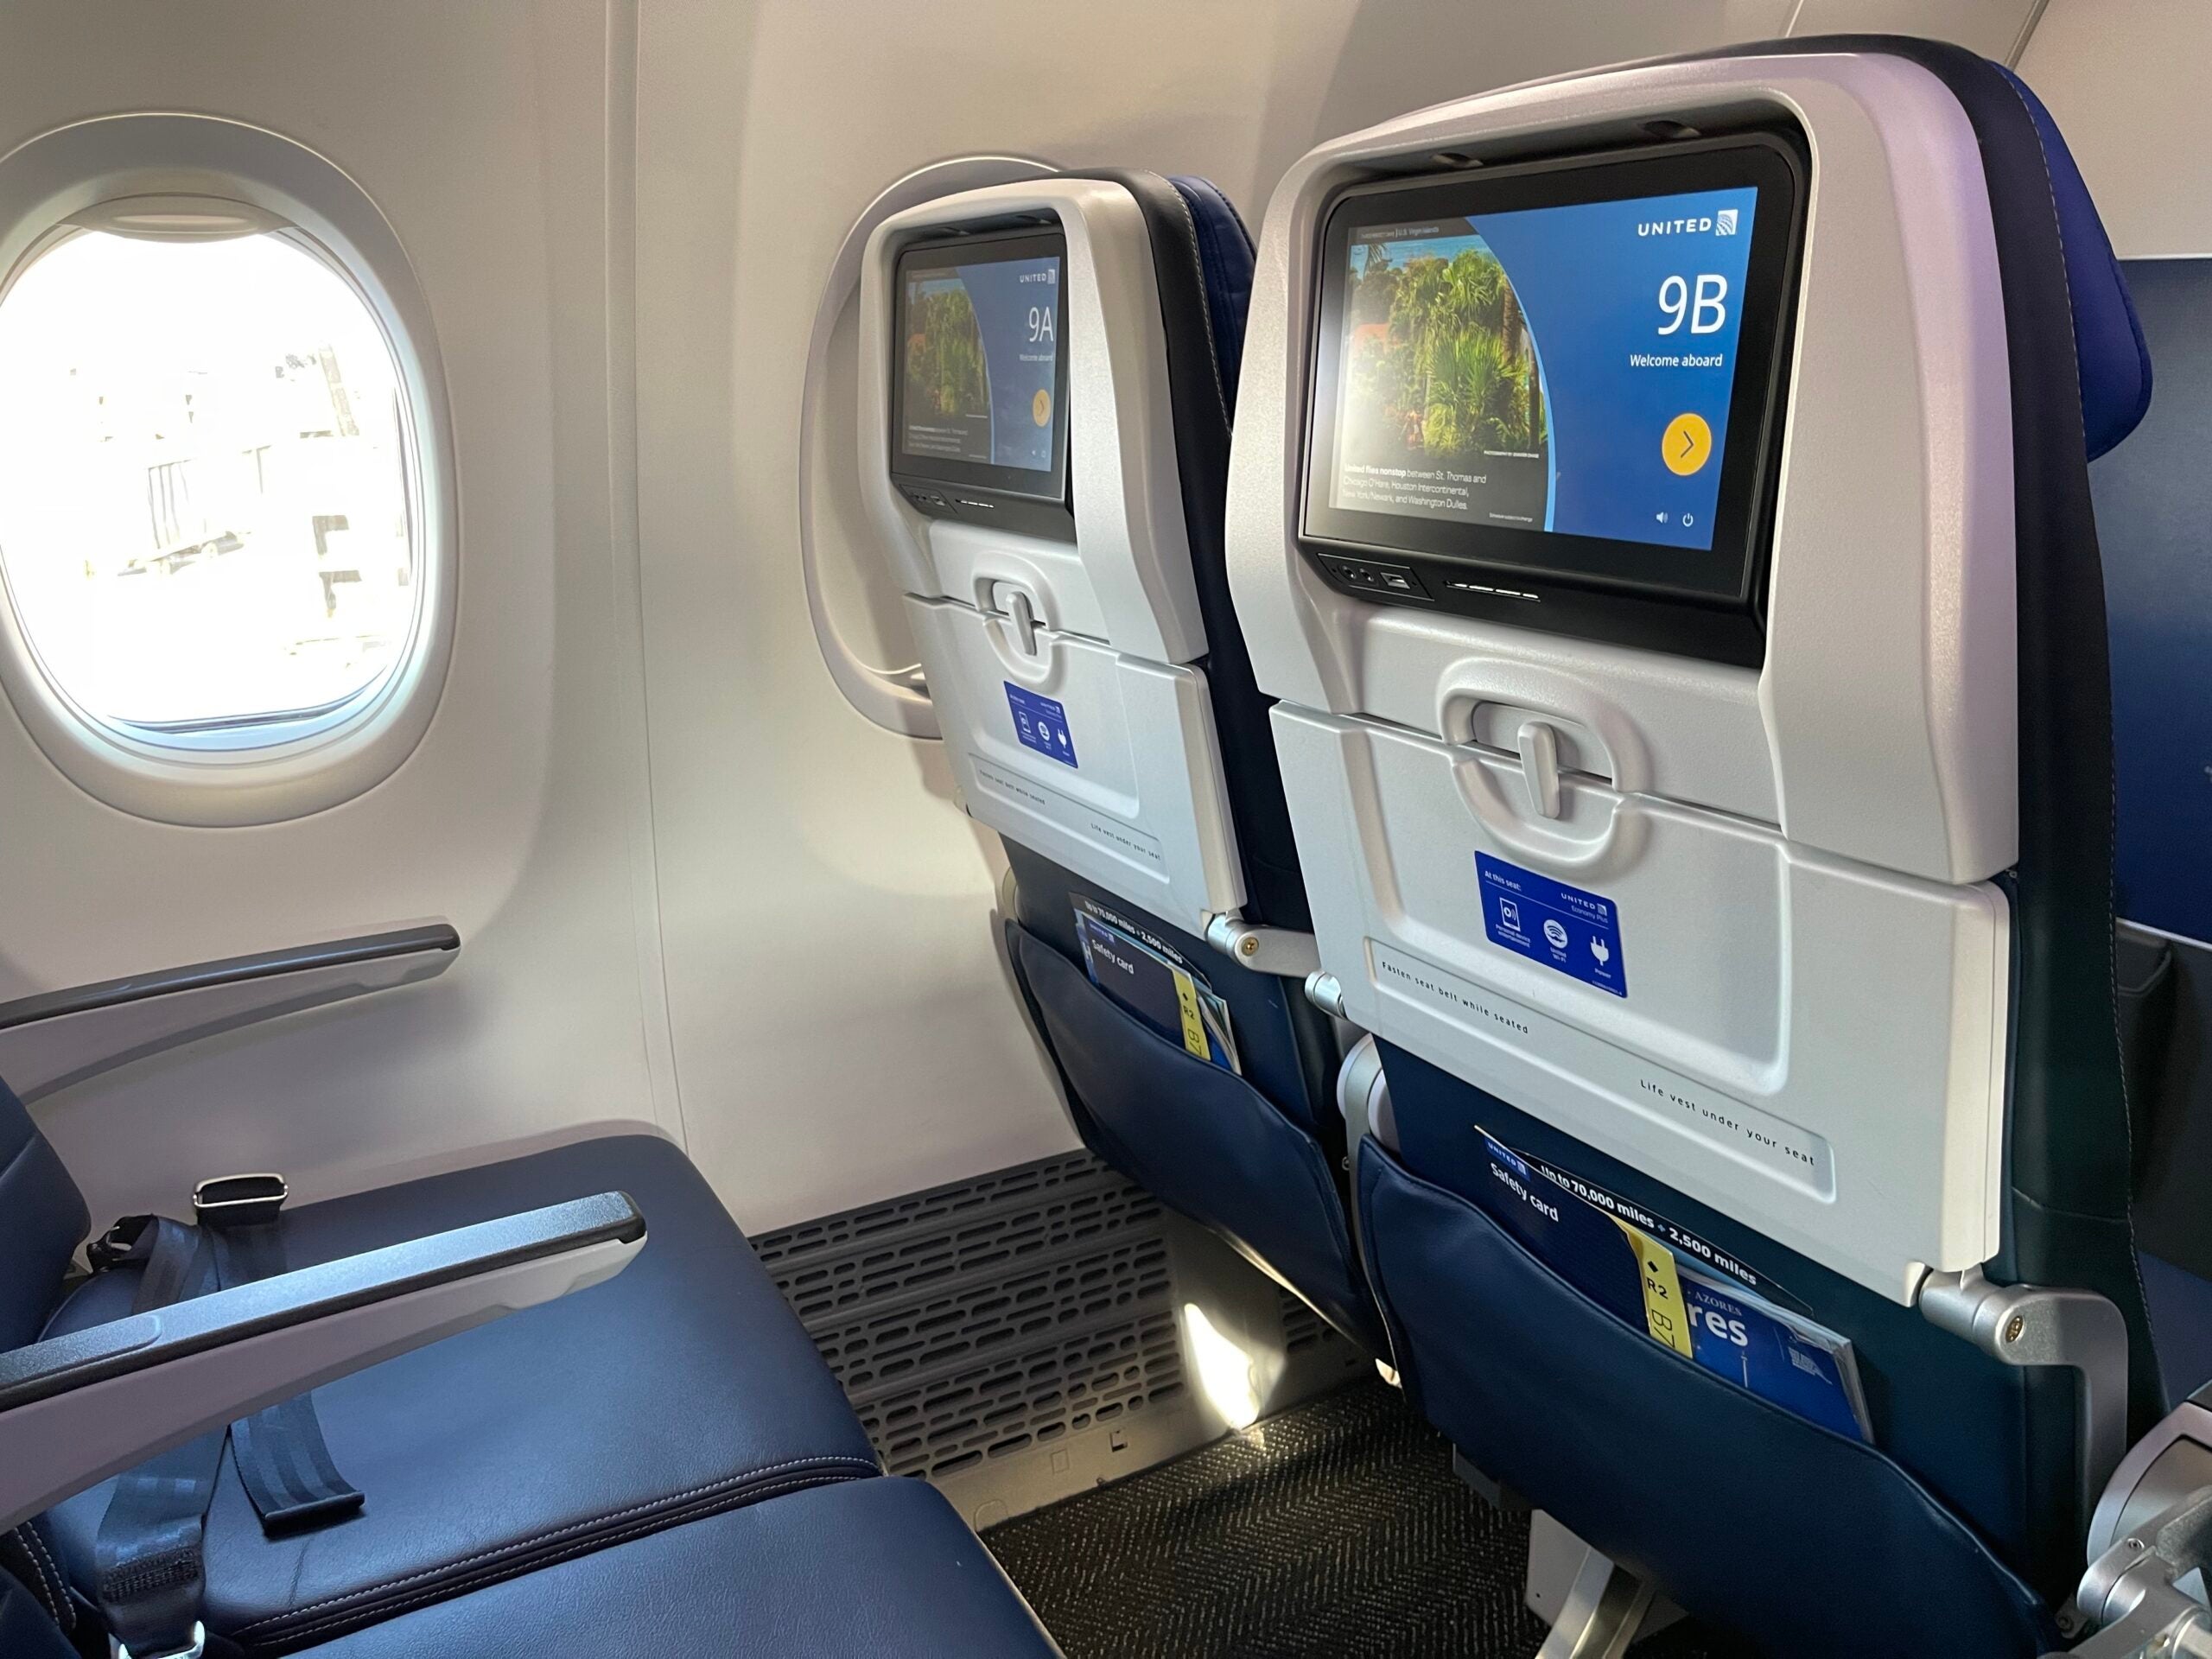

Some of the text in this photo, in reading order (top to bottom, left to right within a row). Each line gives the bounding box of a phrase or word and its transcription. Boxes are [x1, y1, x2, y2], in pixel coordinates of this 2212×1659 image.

[1638, 218, 1712, 236] UNITED
[1020, 273, 1047, 283] UNITED
[1657, 274, 1728, 335] 9B
[1028, 306, 1054, 342] 9A
[1630, 353, 1723, 368] Welcome aboard
[1379, 467, 1407, 479] nonstop
[1407, 469, 1435, 480] between
[1435, 470, 1445, 480] St.
[1446, 471, 1471, 483] Thomas
[1472, 474, 1487, 484] and
[1391, 480, 1416, 492] Houston
[1395, 494, 1408, 504] and
[1408, 495, 1446, 509] Washington
[1484, 870, 1522, 892] At this seat:
[1560, 893, 1596, 910] UNITED
[1091, 939, 1135, 975] Safety card
[1382, 961, 1529, 1034] Fasten seat belt while seated
[1182, 1005, 1195, 1020] R2
[1640, 1078, 1815, 1166] Life vest under your seat
[1487, 1141, 1516, 1166] UNITED
[1491, 1162, 1559, 1223] Safety card
[1557, 1173, 1571, 1189] to
[1571, 1179, 1615, 1211] 70,000
[1617, 1202, 1656, 1229] miles
[1669, 1227, 1712, 1258] 2,500
[1713, 1252, 1757, 1286] miles
[1646, 1277, 1669, 1300] R2
[1695, 1291, 1742, 1317] AZORES
